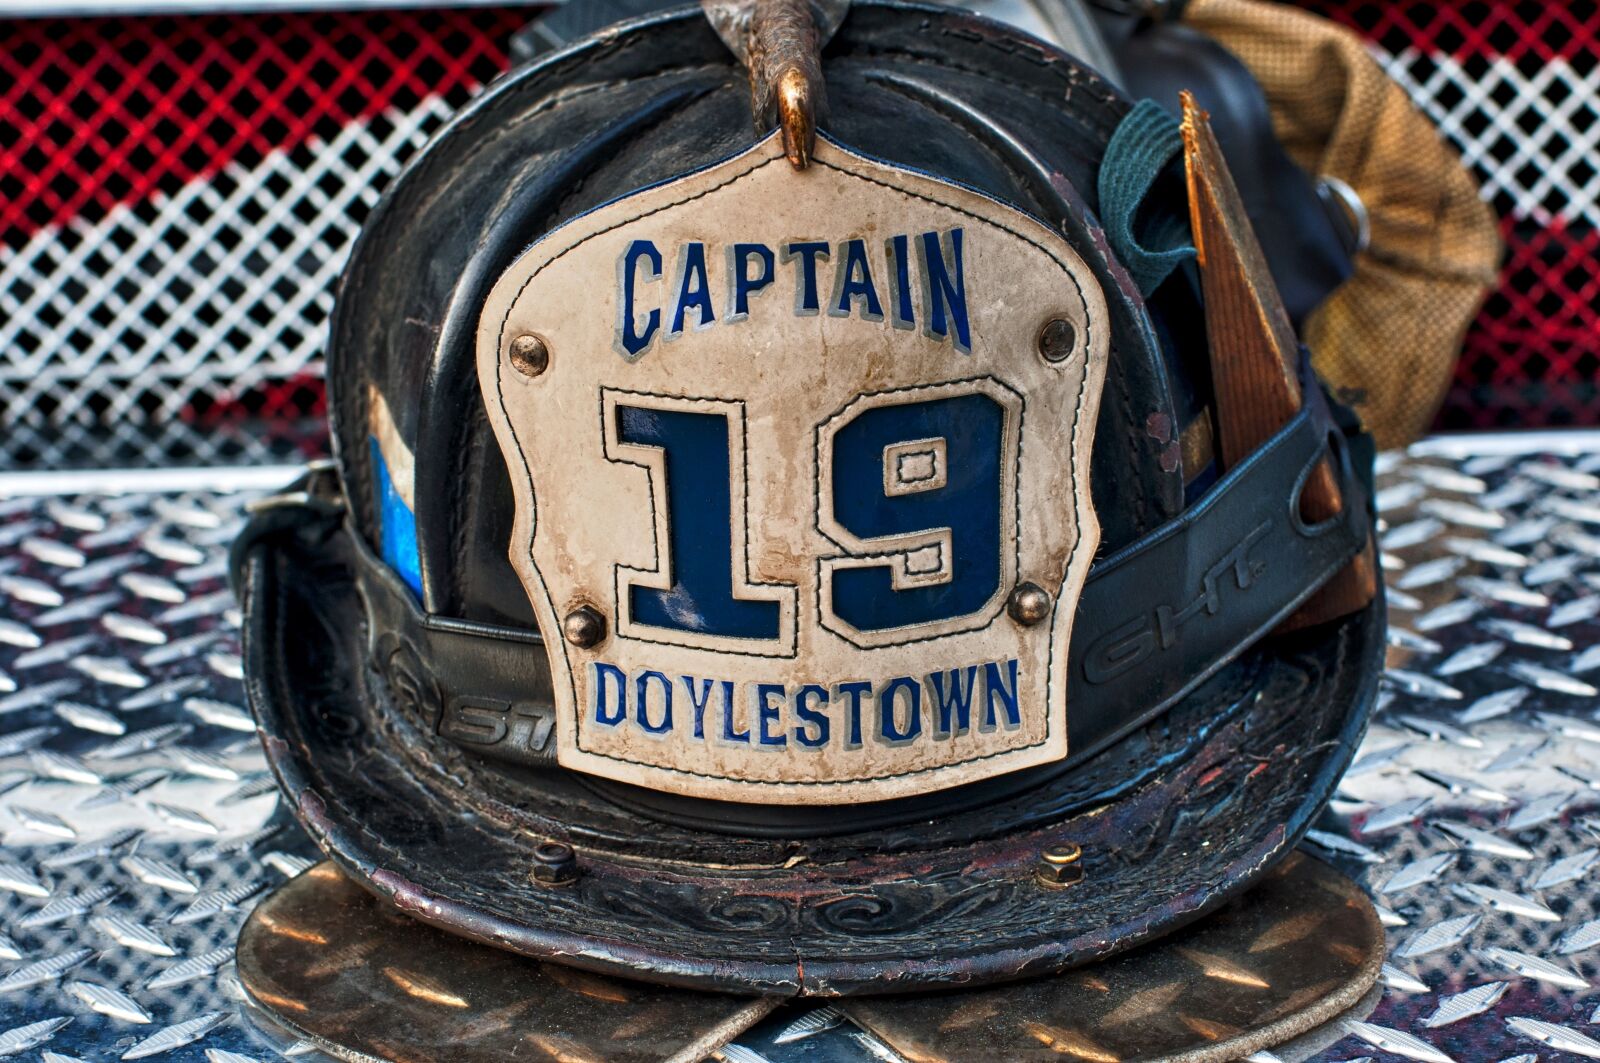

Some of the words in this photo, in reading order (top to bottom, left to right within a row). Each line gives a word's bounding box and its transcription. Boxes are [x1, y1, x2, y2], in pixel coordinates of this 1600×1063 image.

[613, 228, 972, 363] CAPTAIN
[613, 391, 1006, 642] 19
[590, 659, 1021, 751] DOYLESTOWN
